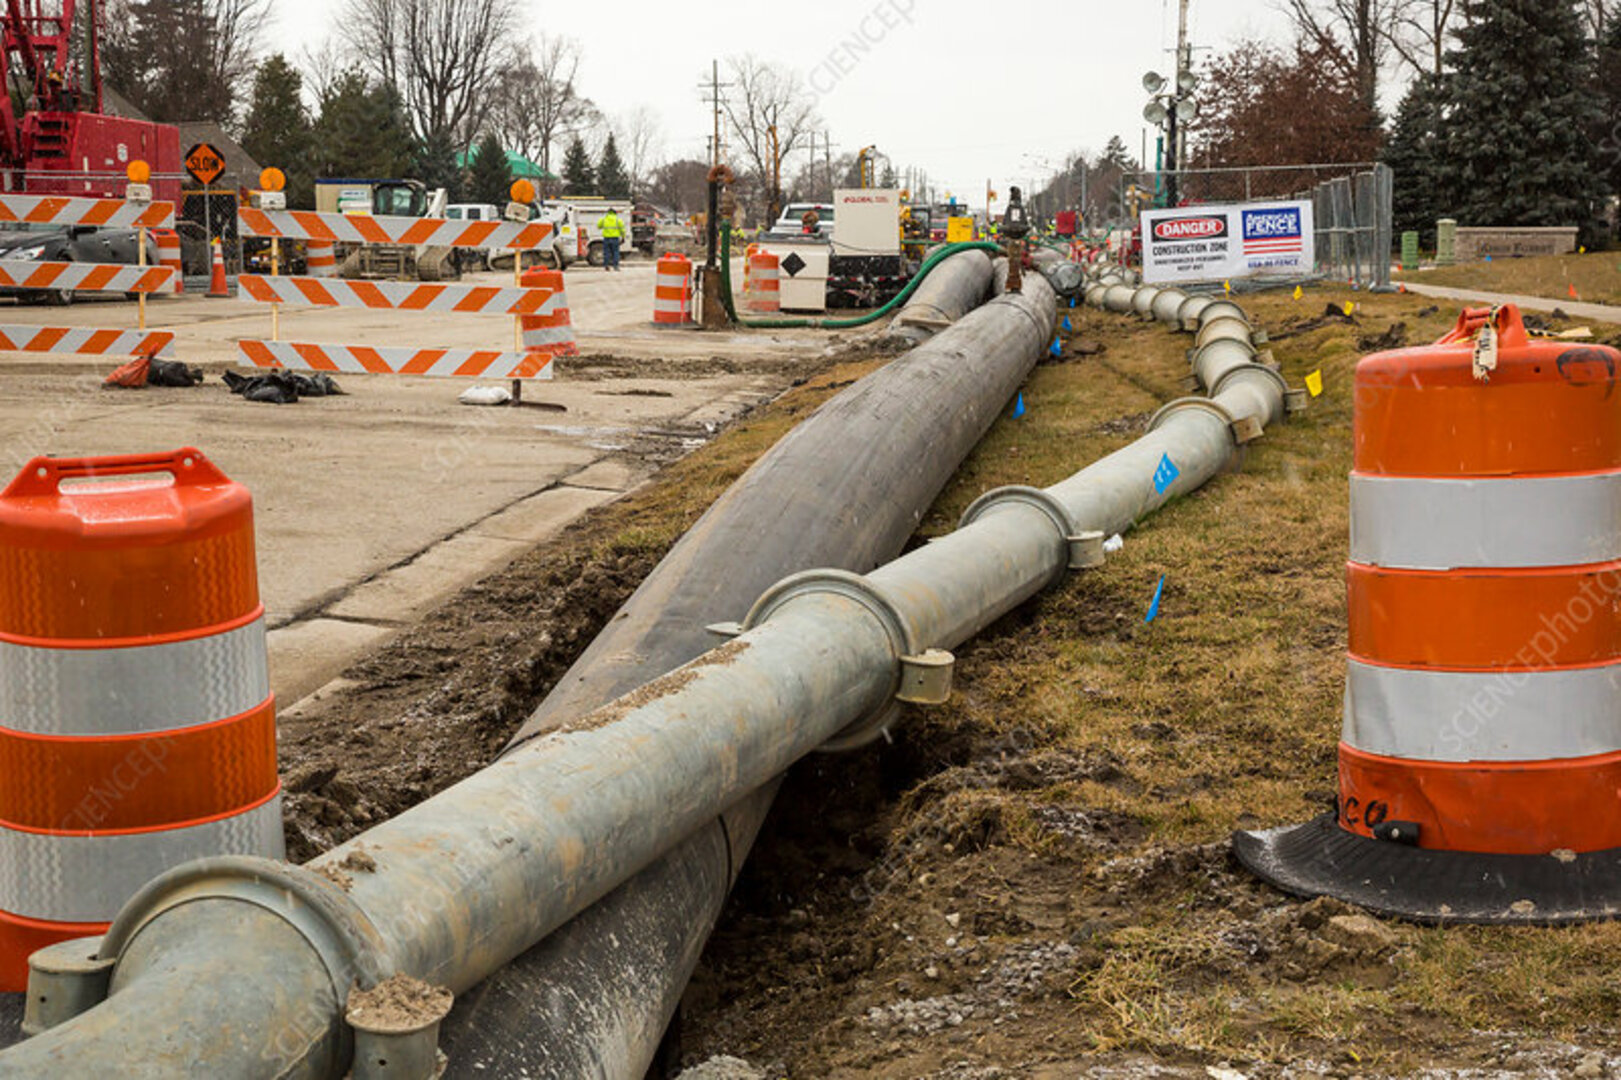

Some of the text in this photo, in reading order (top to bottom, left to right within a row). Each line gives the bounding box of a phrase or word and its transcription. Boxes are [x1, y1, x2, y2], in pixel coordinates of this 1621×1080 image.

[190, 156, 219, 171] SLOW
[1163, 220, 1217, 236] DANGER
[1246, 218, 1298, 232] FENCE
[1152, 241, 1229, 256] CONSTRUCTION ZONE
